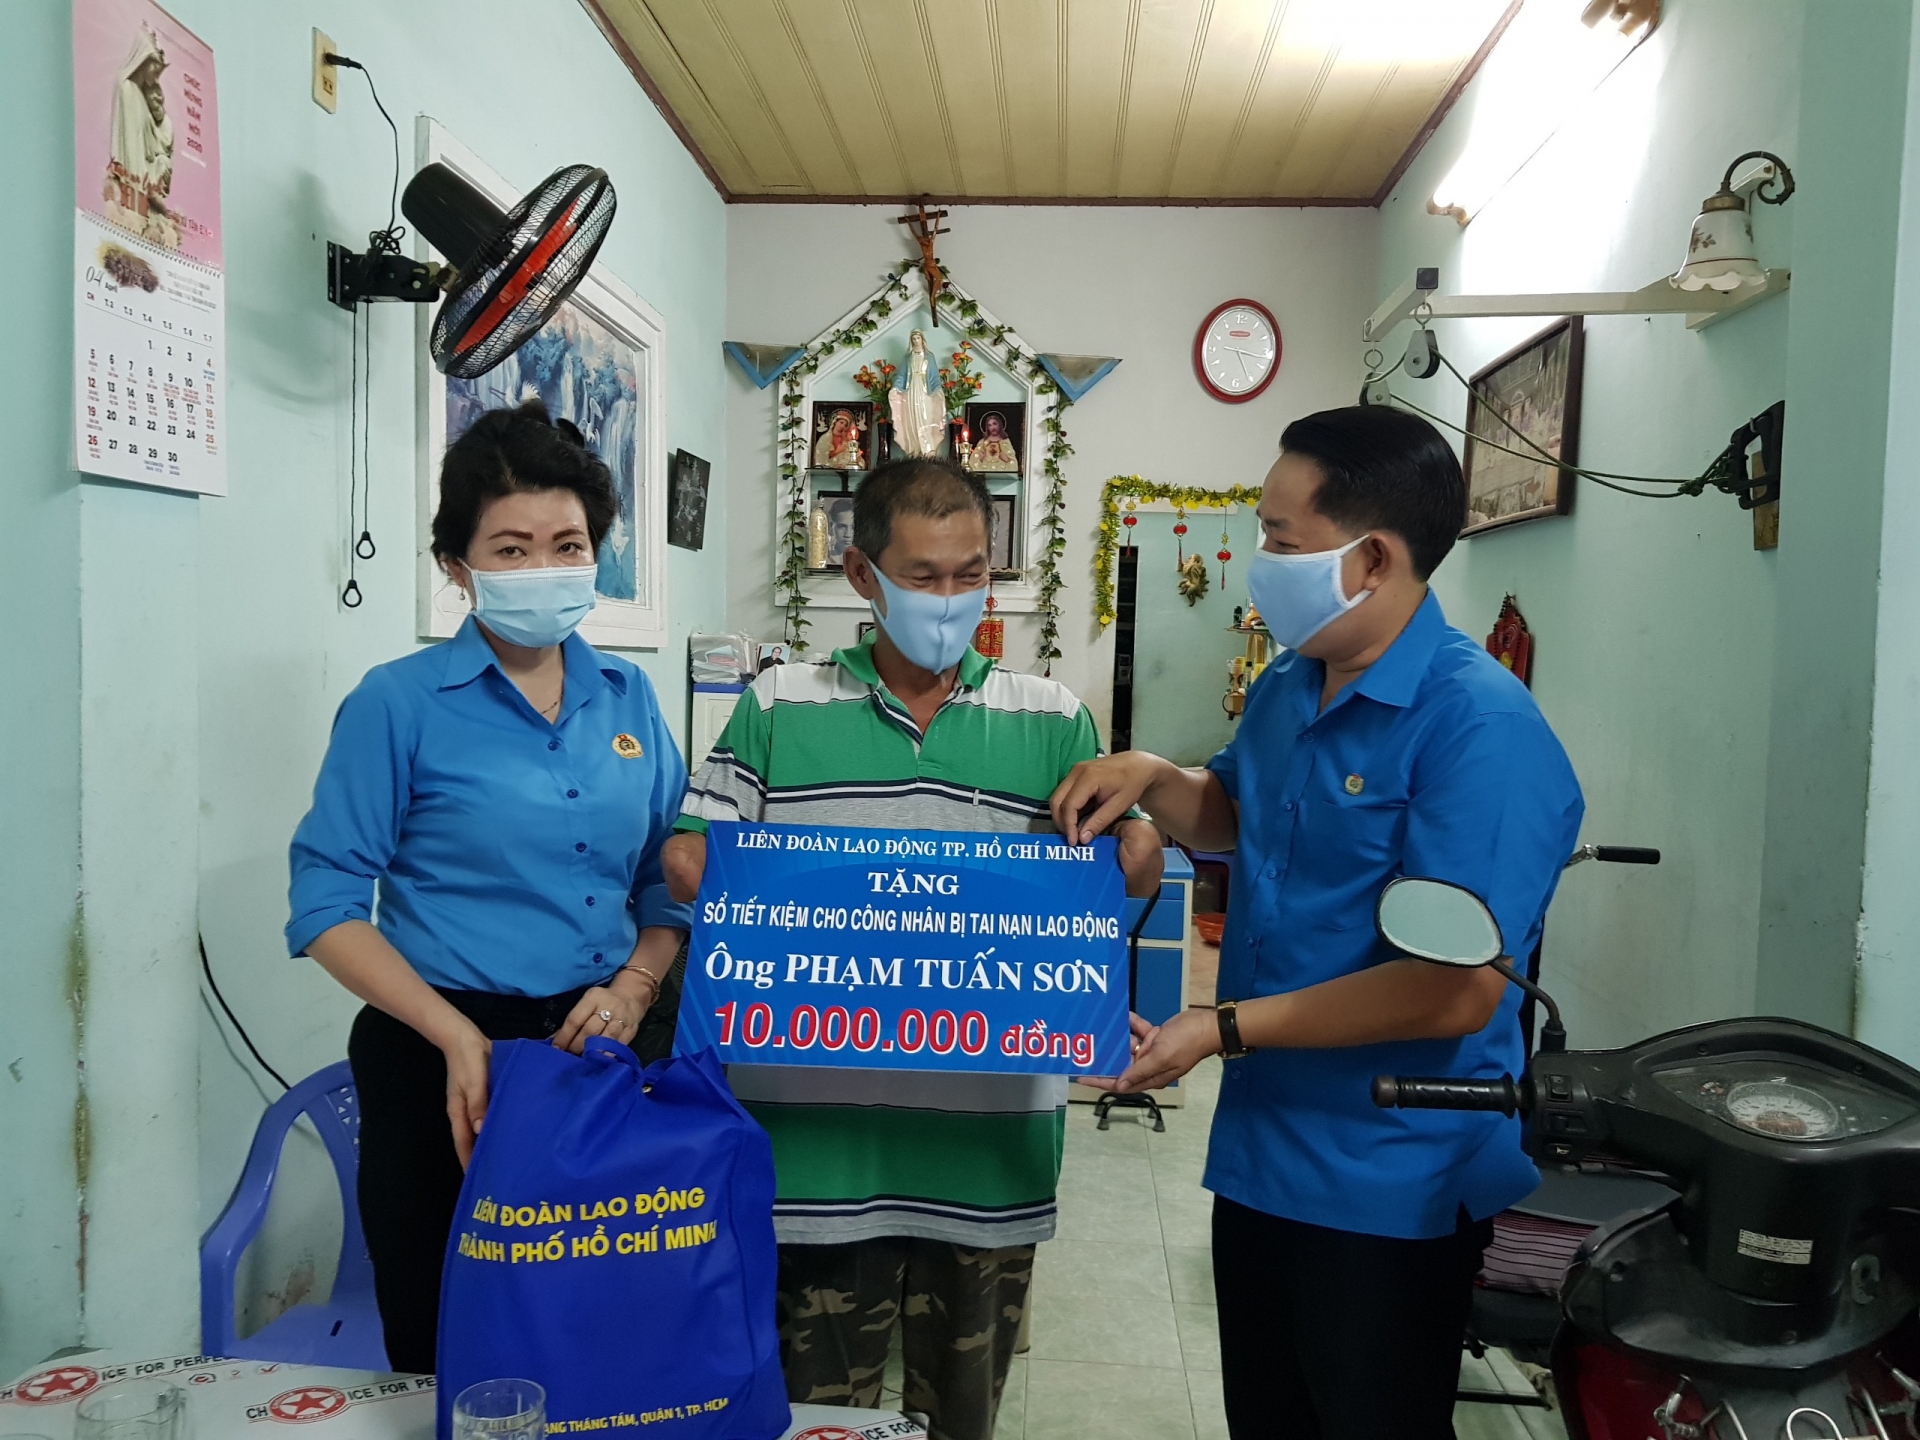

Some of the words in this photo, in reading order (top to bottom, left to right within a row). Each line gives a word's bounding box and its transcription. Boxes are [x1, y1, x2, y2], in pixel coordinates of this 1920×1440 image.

[86, 265, 105, 286] 04
[104, 281, 118, 293] April
[1235, 313, 1248, 324] 12
[90, 348, 95, 359] 5
[109, 354, 114, 364] 6
[128, 360, 134, 371] 7
[147, 366, 153, 377] 8
[168, 372, 173, 382] 9
[184, 377, 193, 388] 10
[206, 383, 212, 393] 11
[1231, 378, 1240, 388] 6
[87, 376, 96, 388] 12
[107, 381, 115, 392] 13
[126, 386, 135, 398] 14
[146, 392, 154, 403] 15
[166, 398, 174, 409] 16
[186, 403, 194, 413] 17
[205, 407, 213, 418] 18
[87, 405, 96, 416] 19
[106, 409, 117, 421] 20
[128, 414, 137, 426] 21
[146, 419, 156, 431] 22
[167, 424, 176, 435] 23
[186, 429, 196, 440] 24
[205, 433, 214, 443] 25
[87, 434, 98, 446] 26
[108, 438, 118, 450] 27
[128, 443, 138, 454] 28
[148, 447, 158, 459] 29
[167, 451, 178, 463] 30
[736, 829, 781, 850] LIÊN
[785, 832, 838, 852] ĐOÀN
[842, 837, 880, 854] LAO
[884, 836, 937, 859] ĐỘNG
[941, 841, 970, 858] TP.
[974, 835, 1002, 859] HỒ
[1006, 840, 1041, 860] CHÍ
[1044, 845, 1095, 862] MINH
[867, 867, 960, 898] TẶNG
[703, 891, 728, 924] SỔ
[731, 895, 766, 924] TIẾT
[769, 900, 809, 932] KIỆM
[812, 906, 848, 930] CHO
[850, 903, 897, 932] CÔNG
[900, 905, 946, 933] NHÂN
[949, 912, 966, 938] BỊ
[969, 912, 995, 935] TAI
[998, 913, 1032, 940] NẠN
[1036, 914, 1068, 938] LAO
[1071, 910, 1119, 941] ĐỘNG
[705, 941, 776, 989] Ông
[784, 953, 905, 992] PHẠM
[914, 946, 1023, 991] TUẤN
[1033, 958, 1109, 994] SƠN
[714, 1001, 989, 1056] 10.000.000
[999, 1019, 1095, 1067] đồng
[500, 1201, 572, 1227] ĐOÀN
[580, 1197, 628, 1221] LAO
[635, 1186, 705, 1219] ĐỘNG
[511, 1230, 565, 1264] PHỐ
[571, 1224, 610, 1258] HỒ
[616, 1224, 659, 1254] CHÍ
[665, 1219, 717, 1250] MINH
[102, 1368, 126, 1380] ICE
[135, 1361, 164, 1376] FOR
[350, 1387, 374, 1401] ICE
[379, 1381, 408, 1395] FOR
[568, 1416, 608, 1433] THÁNG
[609, 1412, 639, 1428] TÁM,
[640, 1407, 673, 1425] QUẬN
[685, 1403, 702, 1416] TP.
